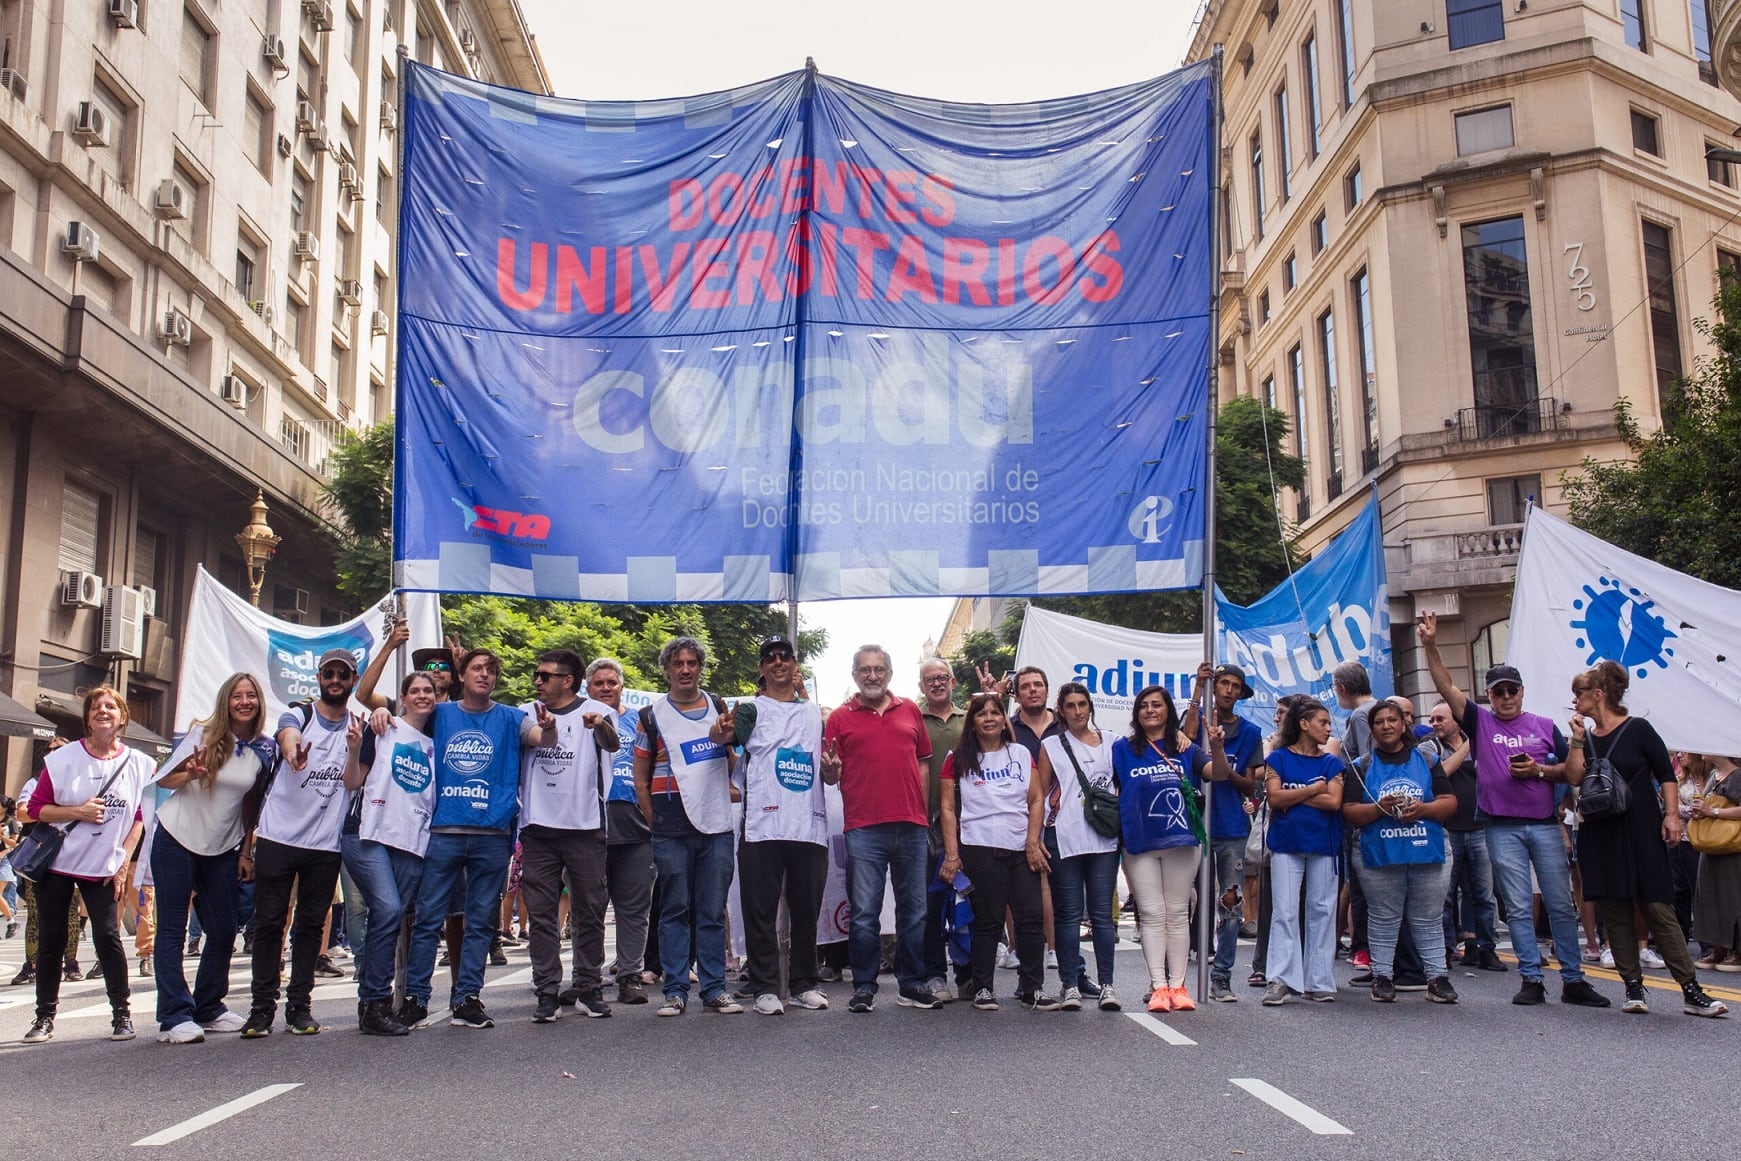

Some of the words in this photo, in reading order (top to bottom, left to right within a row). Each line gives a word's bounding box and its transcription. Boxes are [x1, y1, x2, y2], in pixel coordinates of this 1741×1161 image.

[668, 157, 956, 233] DOCENTES
[497, 218, 1125, 315] UNIVERSITARIOS
[1563, 242, 1597, 312] 725
[1563, 323, 1607, 337] Continental
[573, 327, 1034, 455] conadu
[876, 463, 996, 492] Nacional
[1005, 463, 1040, 492] de
[853, 495, 1040, 525] Universitarios
[443, 740, 493, 764] pública
[395, 754, 429, 776] aduna
[396, 767, 426, 783] asociación
[778, 758, 813, 774] aduna
[780, 771, 812, 780] asociación
[301, 766, 344, 788] públi
[1380, 824, 1428, 839] conadu
